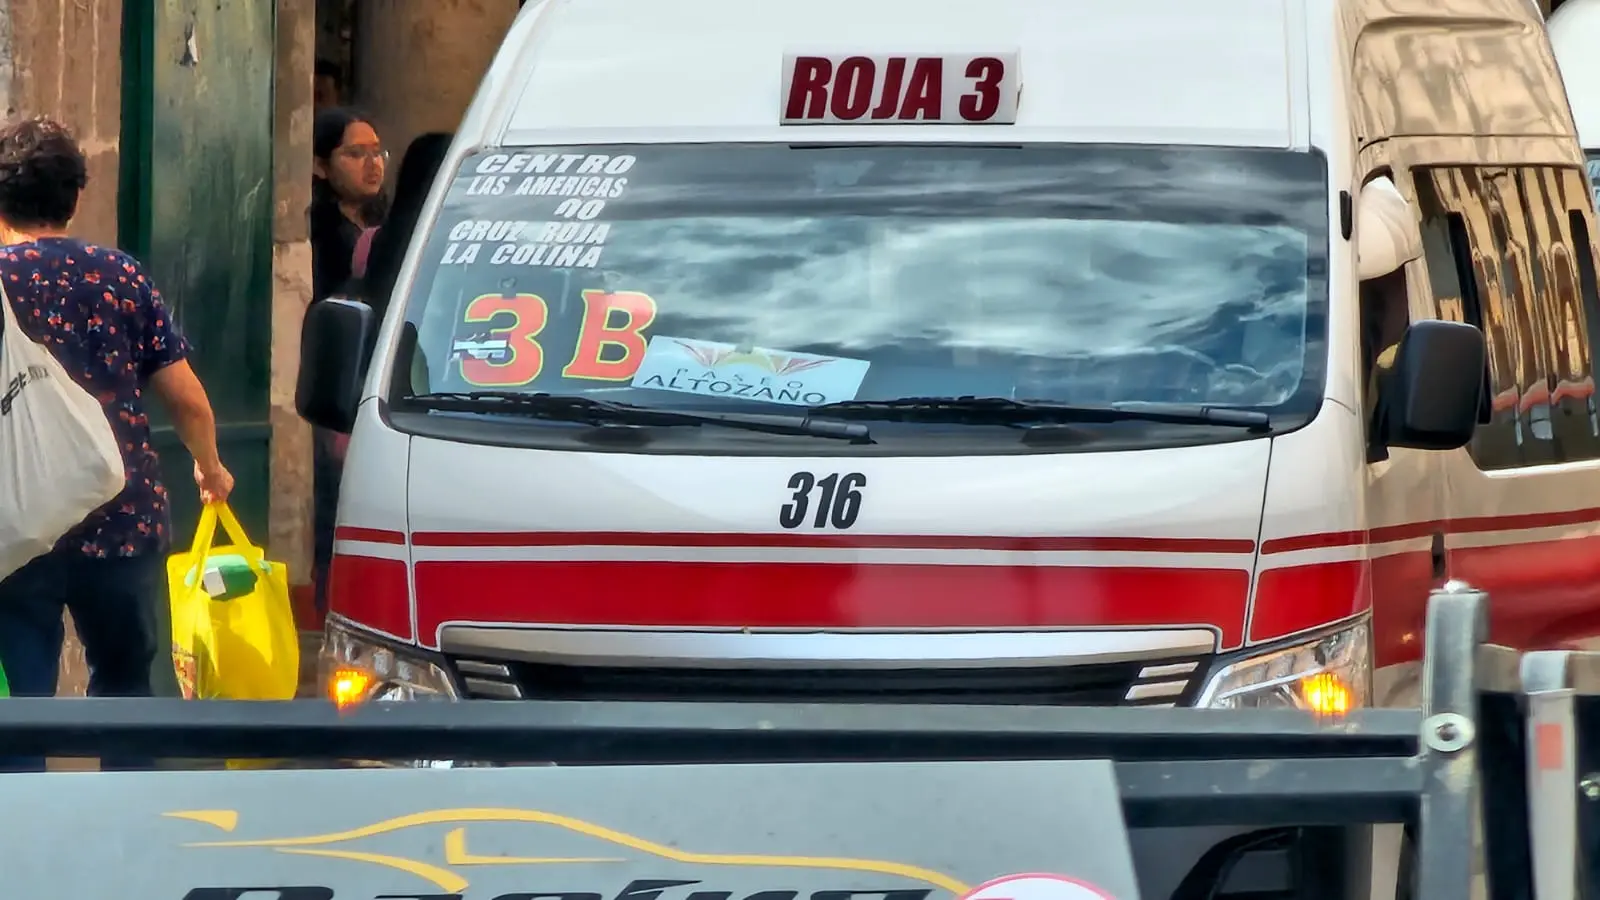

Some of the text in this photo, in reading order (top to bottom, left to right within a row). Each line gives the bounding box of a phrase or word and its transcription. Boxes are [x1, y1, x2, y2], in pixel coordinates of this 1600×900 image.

[785, 56, 1005, 122] ROJA 3
[475, 154, 637, 174] CENTRO
[466, 175, 628, 198] LAS AMERICAS
[447, 220, 612, 245] CRUZ ROJA
[439, 243, 605, 269] LA COLINA
[460, 288, 657, 386] 3 B
[779, 471, 867, 530] 316
